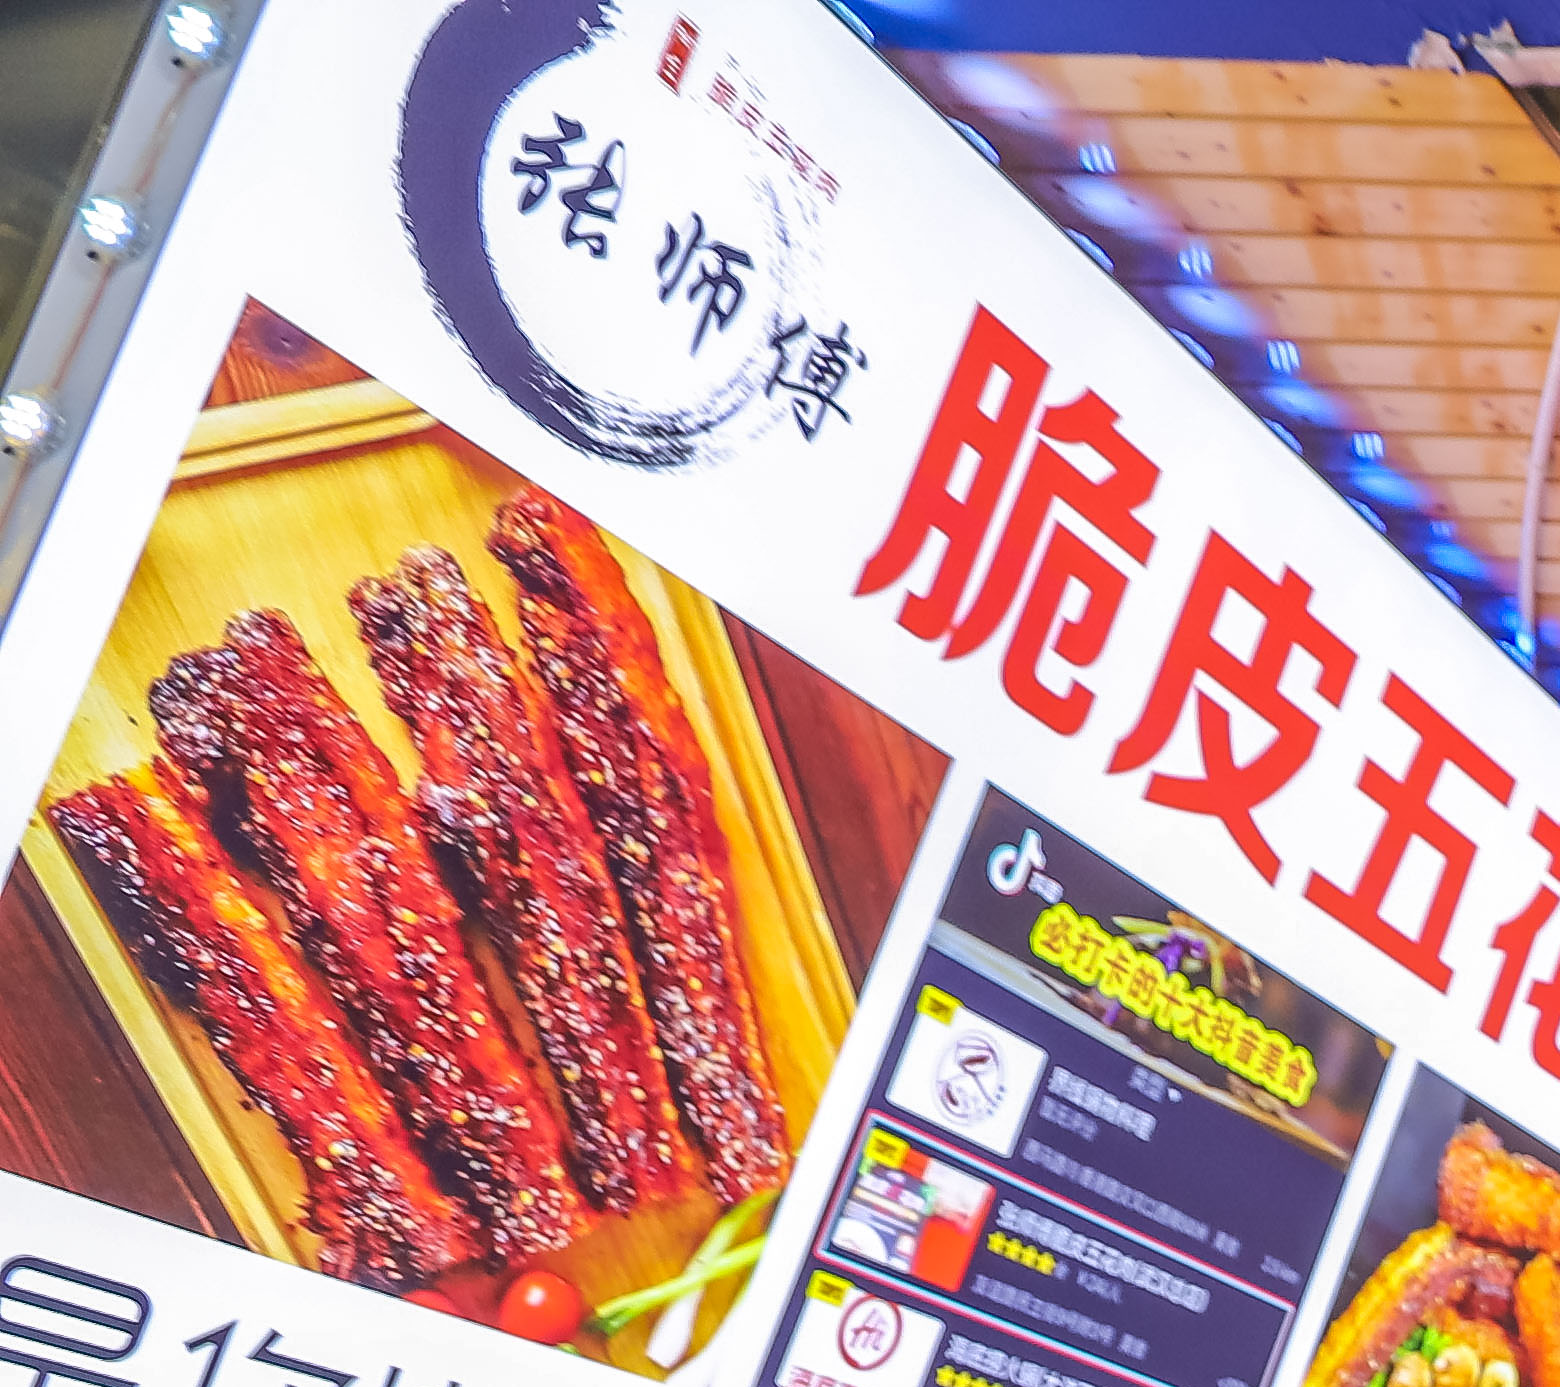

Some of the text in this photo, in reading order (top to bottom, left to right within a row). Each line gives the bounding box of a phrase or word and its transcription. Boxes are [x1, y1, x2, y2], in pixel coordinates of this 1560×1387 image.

[511, 112, 868, 441] 张师傅
[1038, 908, 1312, 1100] 必打卡的十大抖音美食
